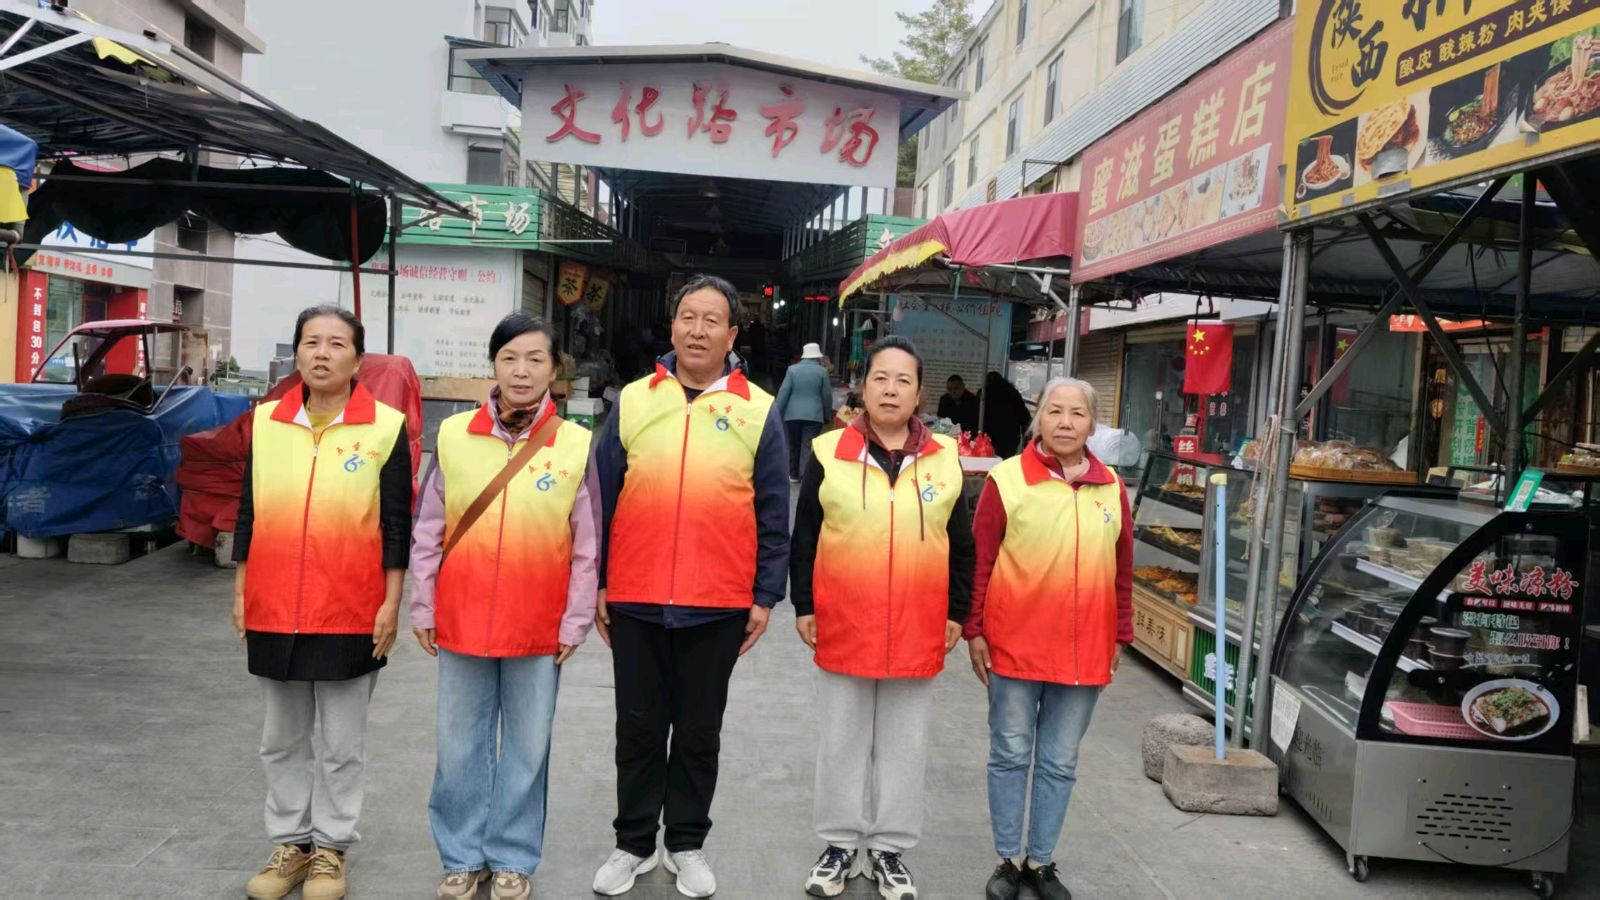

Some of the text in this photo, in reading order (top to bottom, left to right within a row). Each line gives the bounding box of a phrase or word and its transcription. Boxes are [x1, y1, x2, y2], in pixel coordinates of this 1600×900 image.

[1438, 22, 1497, 63] 酸辣粉
[546, 82, 880, 168] 文化路市场
[1088, 61, 1276, 216] 蜜滋蛋糕店
[1461, 560, 1579, 600] 美味凉粉
